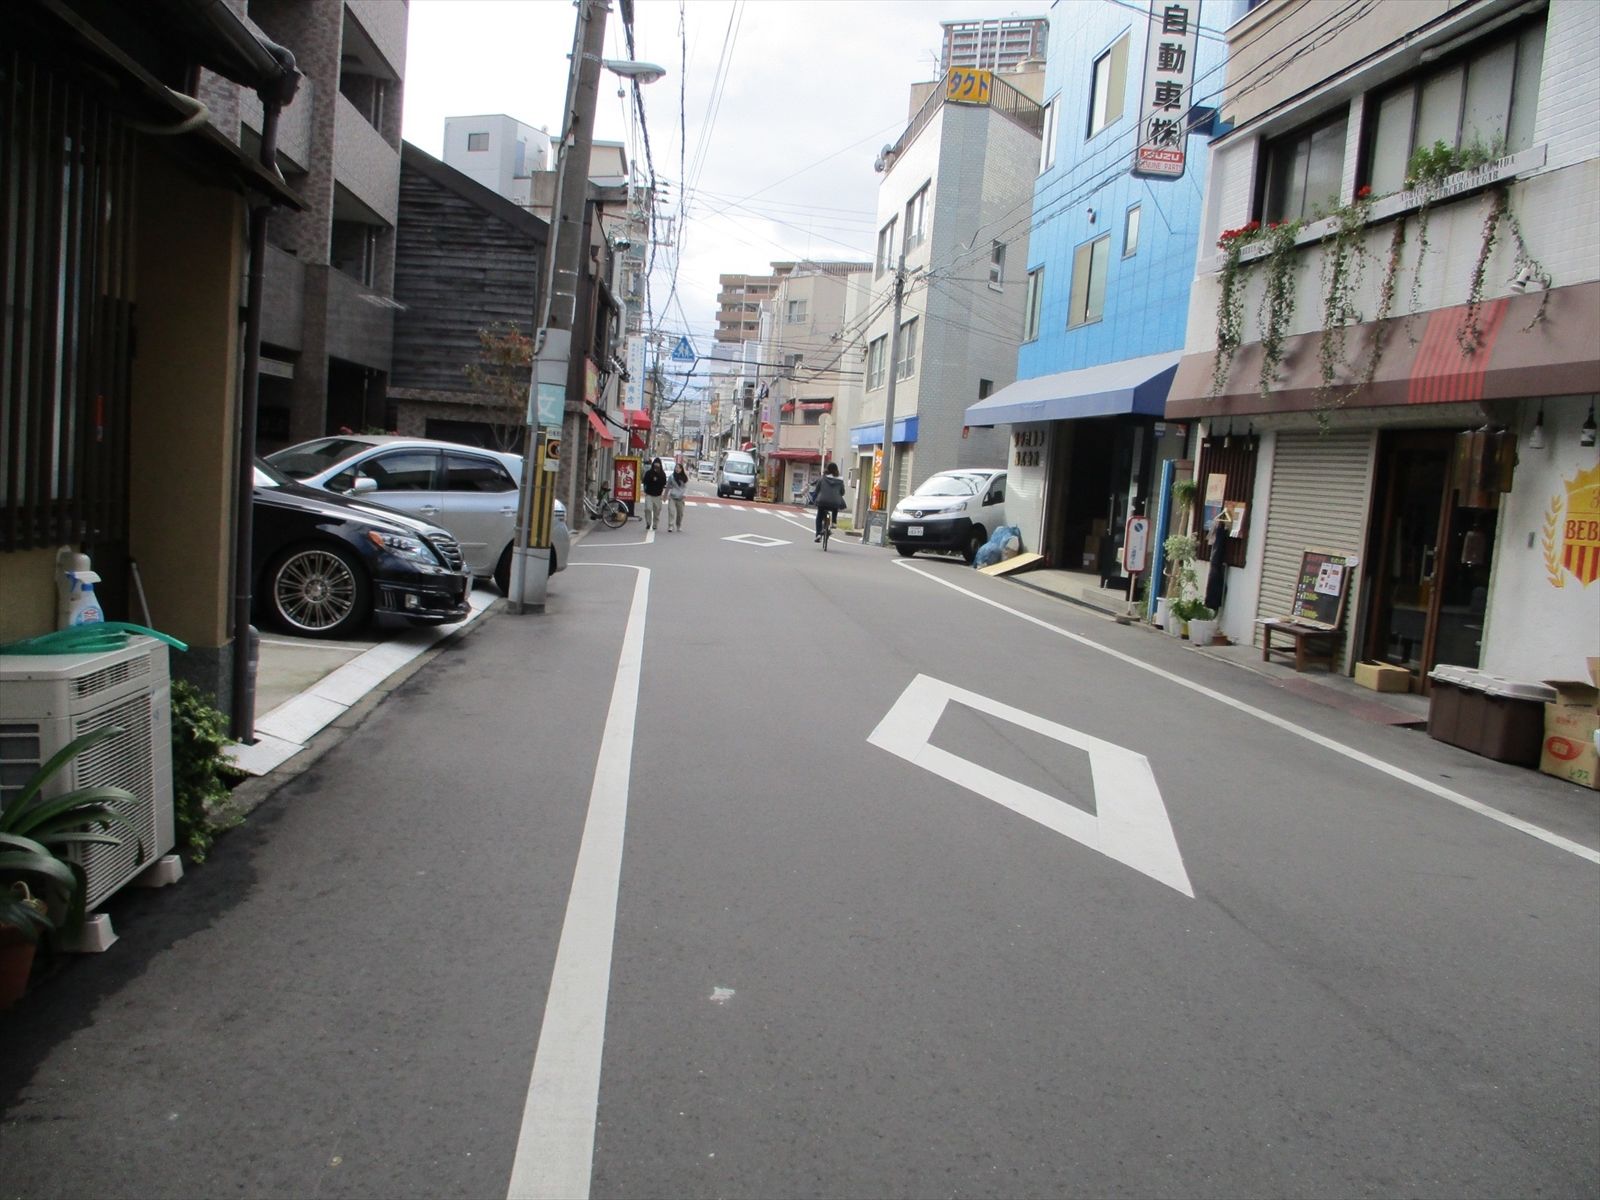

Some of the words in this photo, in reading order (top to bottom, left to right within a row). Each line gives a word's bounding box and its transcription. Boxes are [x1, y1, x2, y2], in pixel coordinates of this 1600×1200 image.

[950, 71, 988, 97] タクト
[1142, 150, 1181, 161] ISUZU
[1565, 520, 1600, 541] BEB
